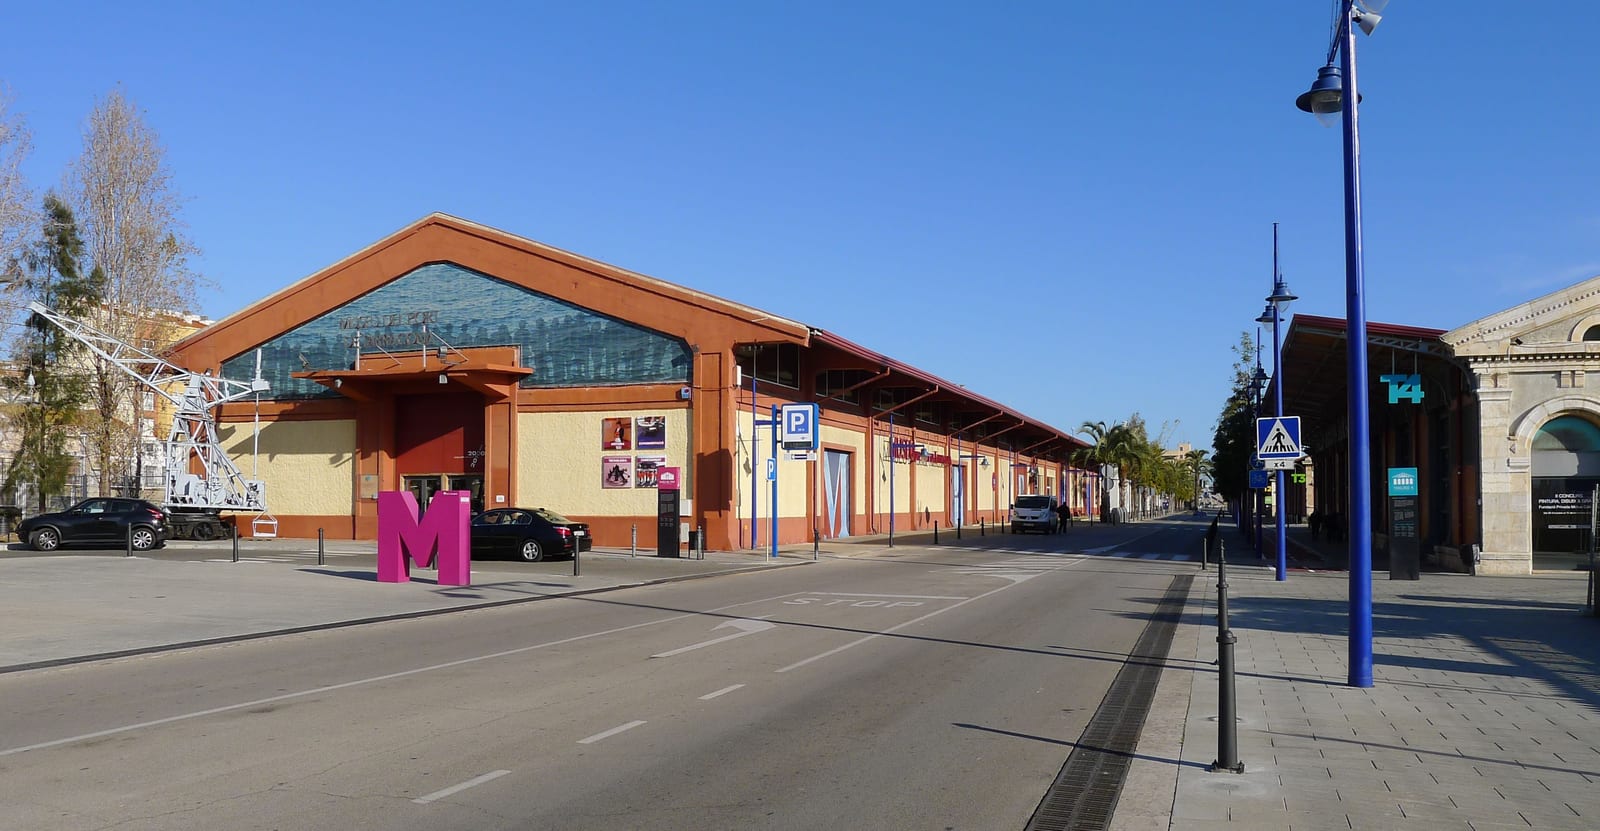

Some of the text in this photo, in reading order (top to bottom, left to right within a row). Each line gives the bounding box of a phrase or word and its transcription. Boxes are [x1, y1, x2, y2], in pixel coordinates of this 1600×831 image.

[1380, 374, 1425, 404] T4
[792, 412, 805, 432] P
[769, 463, 775, 478] P
[1292, 474, 1306, 484] T3
[377, 491, 471, 586] M
[783, 598, 925, 608] STOP
